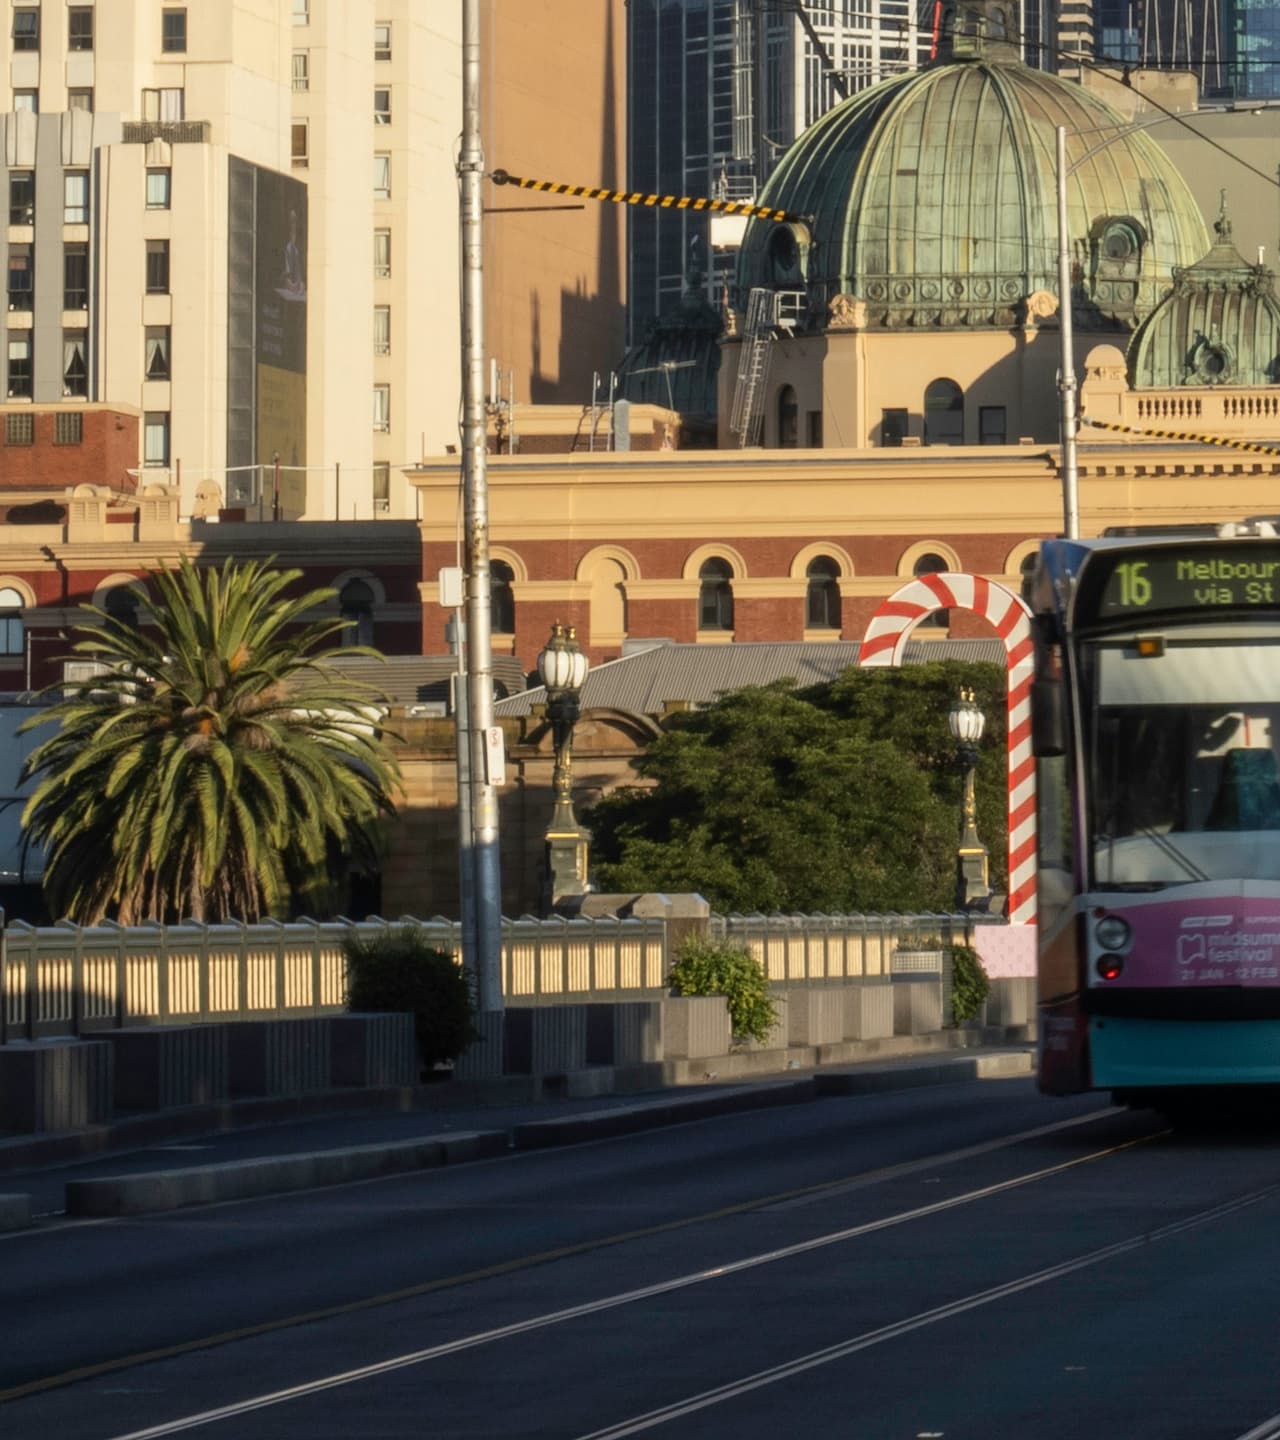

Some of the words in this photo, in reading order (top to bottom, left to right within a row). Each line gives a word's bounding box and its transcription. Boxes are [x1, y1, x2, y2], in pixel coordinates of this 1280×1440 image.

[1115, 562, 1151, 606] 16
[1194, 583, 1233, 604] via
[1245, 582, 1273, 603] St
[1208, 947, 1273, 962] festival
